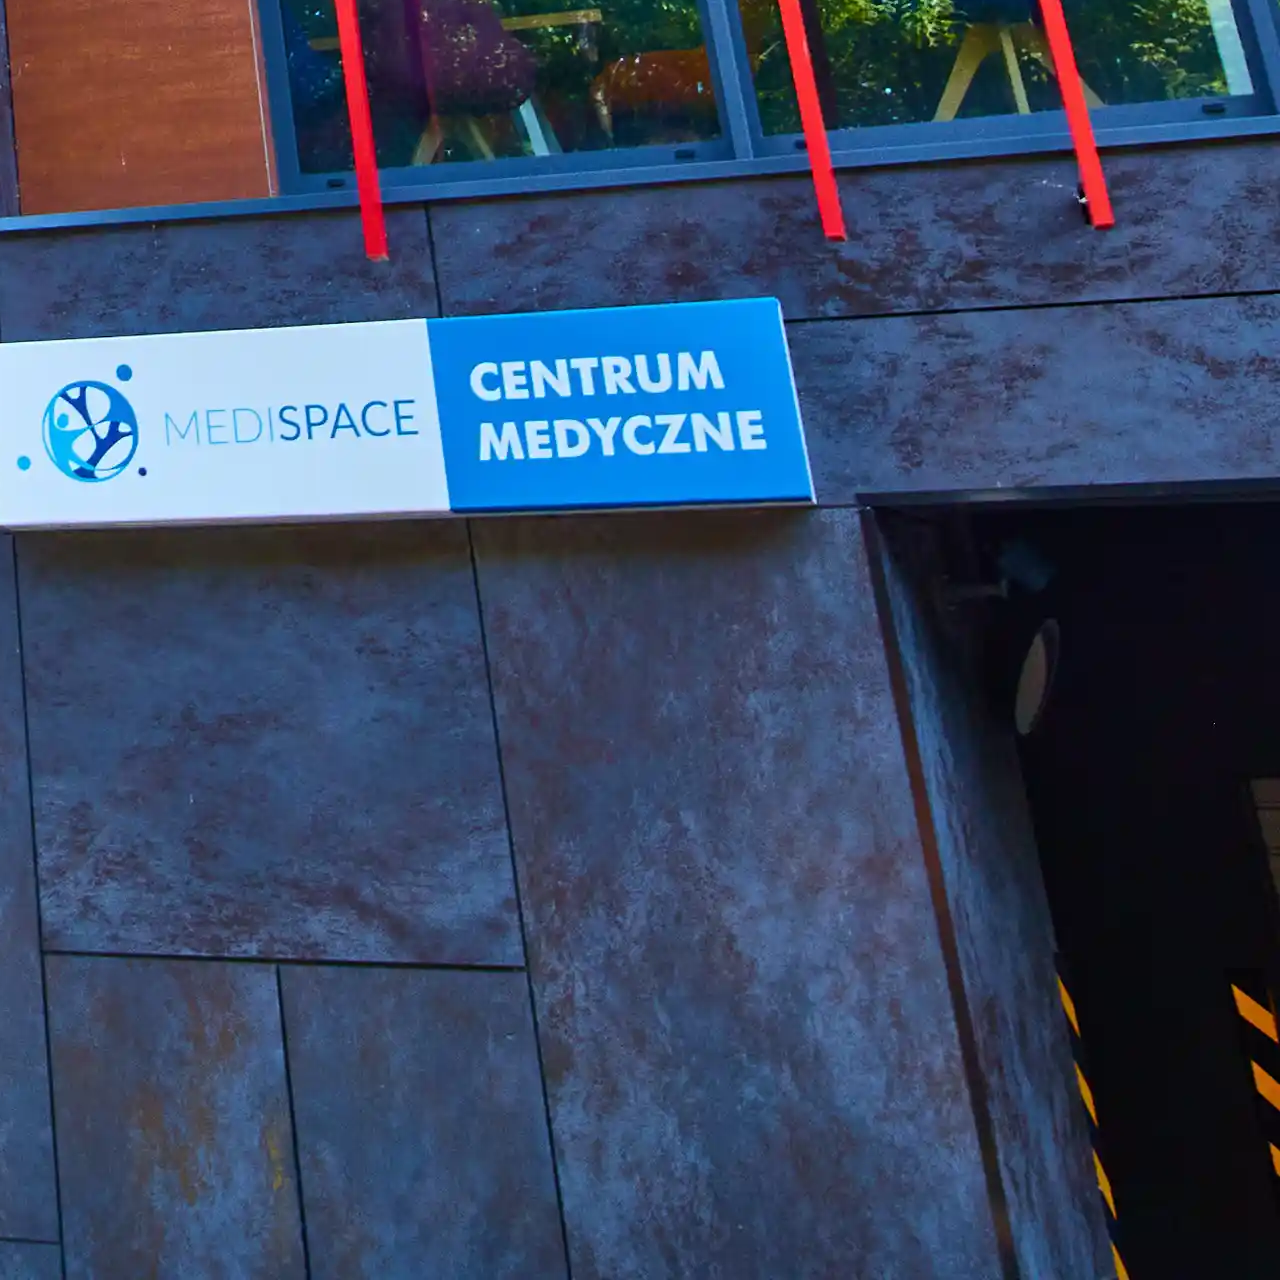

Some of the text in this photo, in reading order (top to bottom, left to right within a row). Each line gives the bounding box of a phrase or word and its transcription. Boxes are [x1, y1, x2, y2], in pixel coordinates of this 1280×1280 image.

[469, 350, 726, 402] CENTRUM
[163, 398, 420, 446] MEDISPACE
[478, 409, 768, 462] MEDYCZNE
